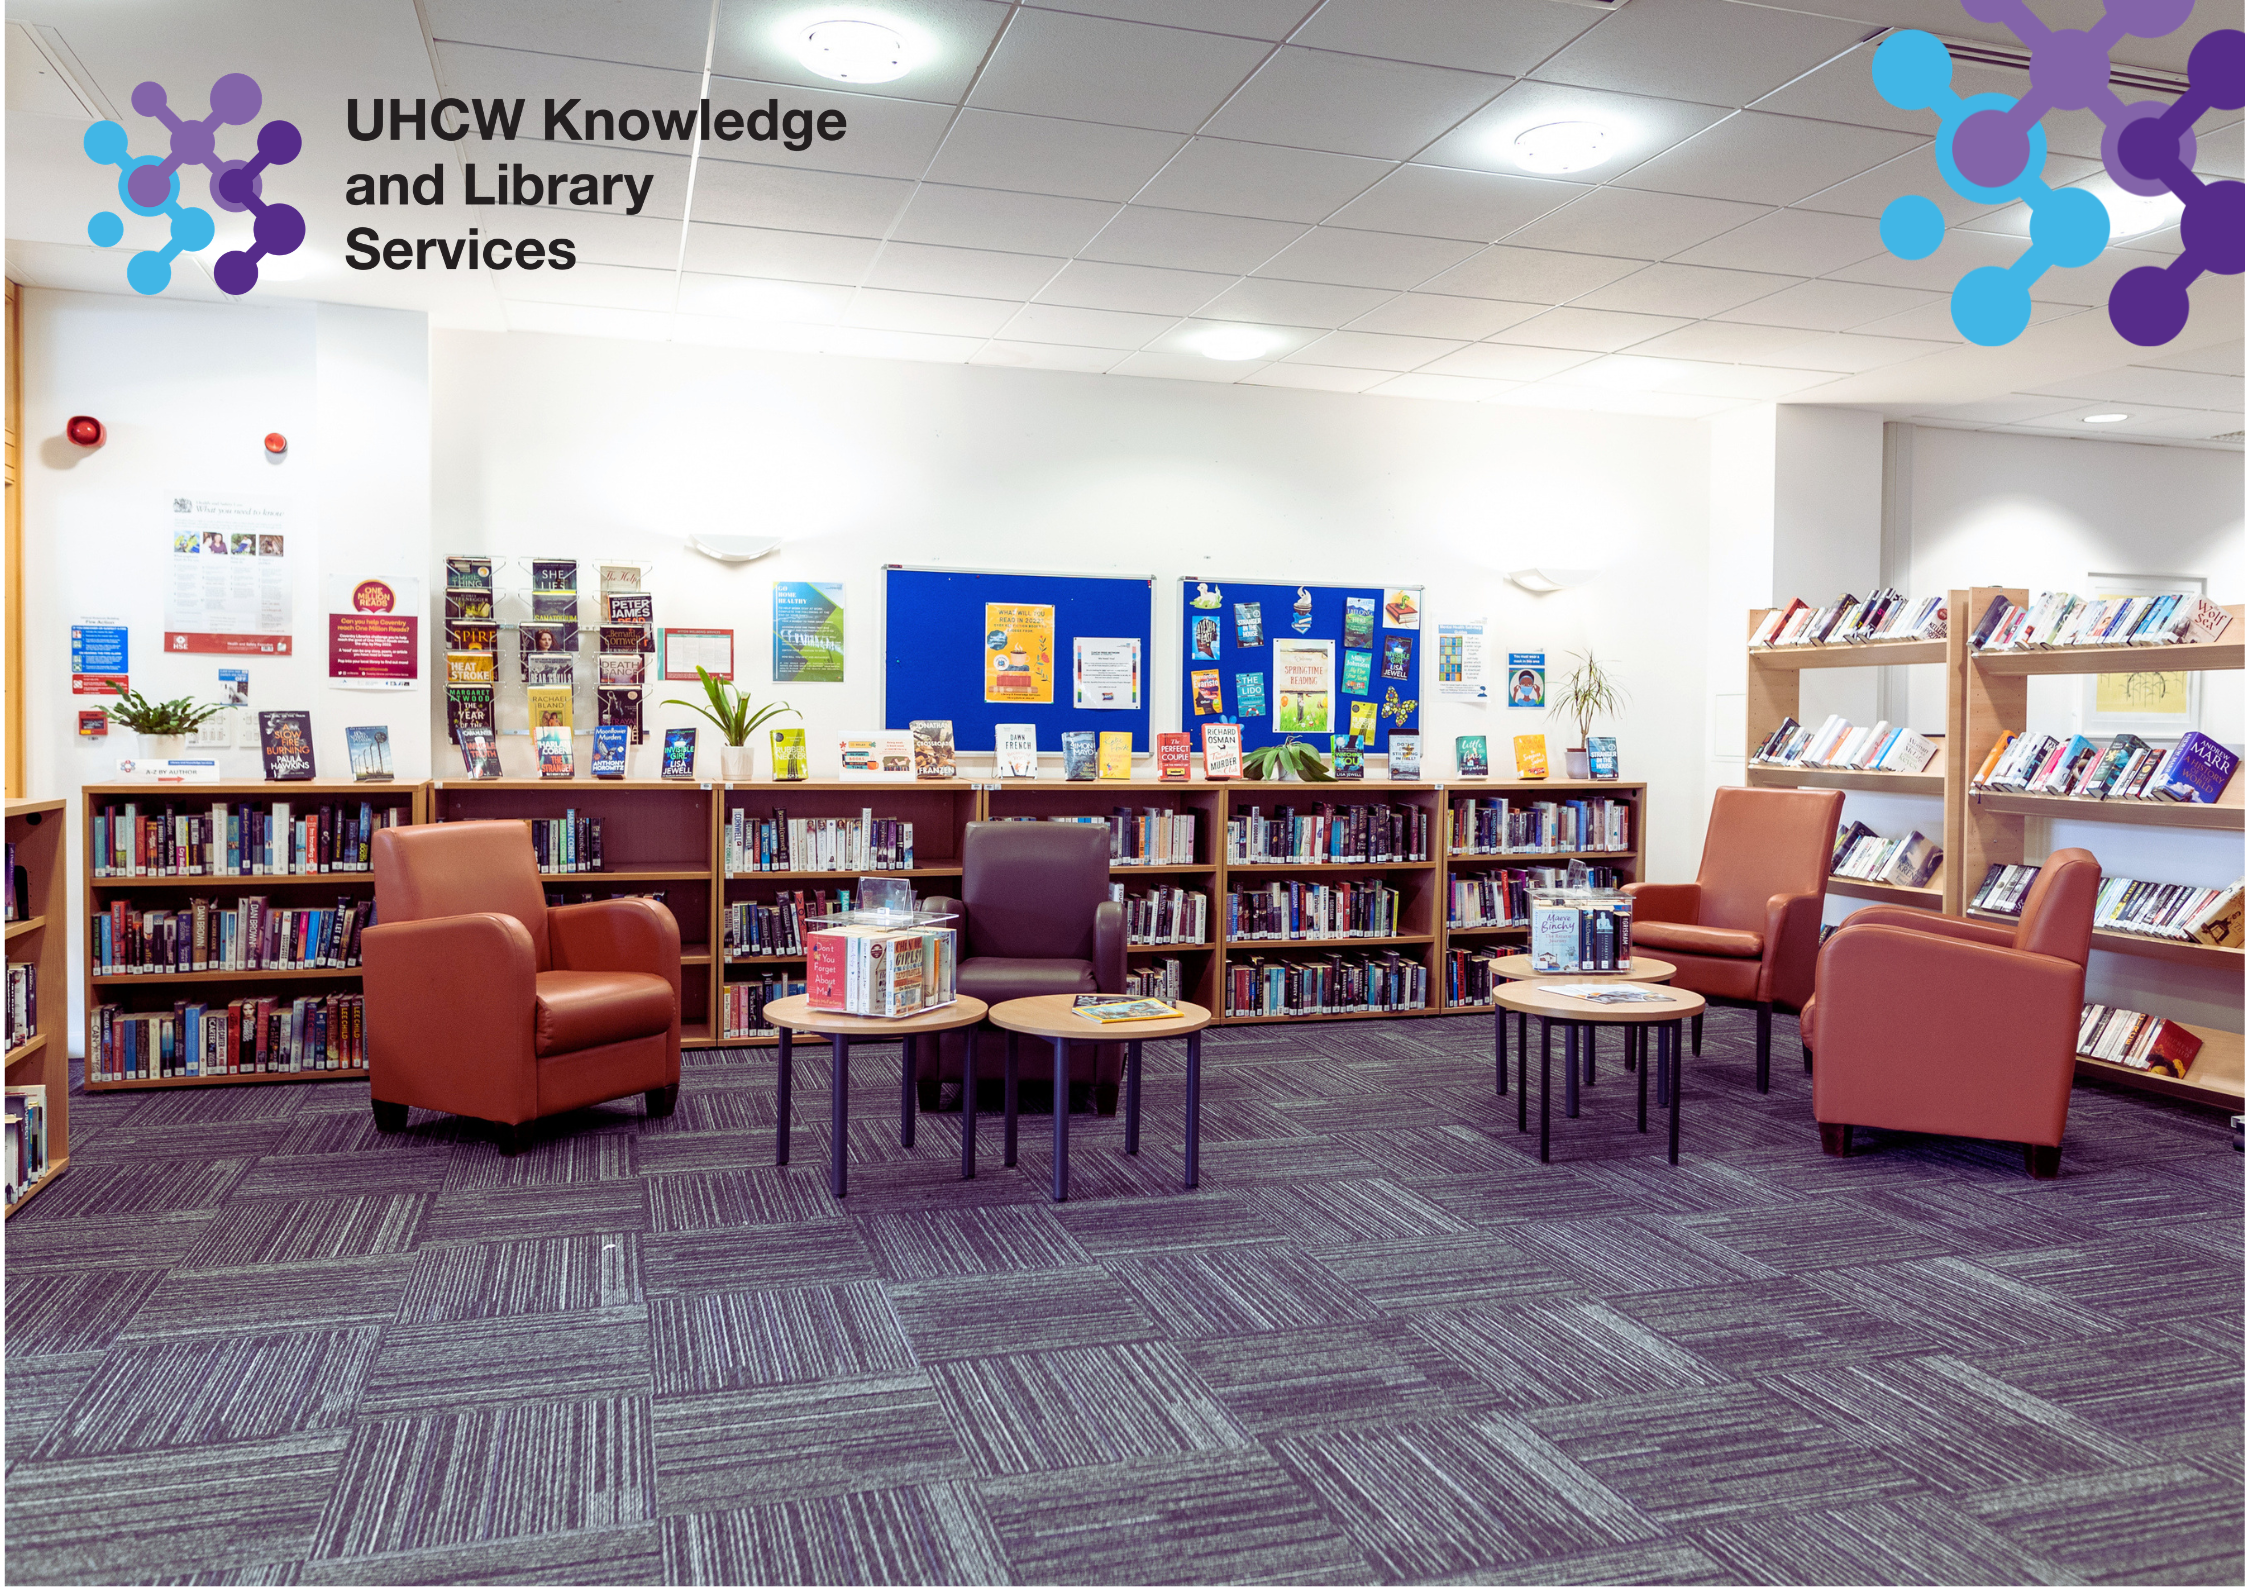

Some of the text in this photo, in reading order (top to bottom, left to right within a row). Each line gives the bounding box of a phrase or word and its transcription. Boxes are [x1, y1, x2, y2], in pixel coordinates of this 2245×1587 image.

[263, 508, 284, 517] know
[542, 570, 564, 579] SHE
[358, 592, 390, 600] MILLION
[612, 600, 650, 609] PETER
[612, 608, 650, 618] JAMES
[2198, 598, 2227, 627] Wolf
[2194, 612, 2214, 630] Sea
[454, 630, 497, 642] SPIRE
[451, 662, 476, 671] HEAT
[1284, 666, 1323, 674] SPRINGTIME
[452, 671, 490, 680] STROKE
[1290, 676, 1317, 685] READING
[458, 712, 484, 720] YEAR
[274, 730, 302, 739] SLOW
[282, 738, 300, 746] FIRE
[1006, 742, 1032, 750] FRENCH
[266, 746, 310, 755] BURNING
[2201, 740, 2230, 760] ANDREW
[2190, 742, 2230, 775] MARR
[270, 762, 310, 770] HAWKINS
[542, 763, 574, 772] STRANGER
[1210, 757, 1237, 770] MURDER
[2191, 759, 2225, 784] HISTORY
[2182, 768, 2214, 793] WORLD
[2201, 773, 2212, 783] THE
[337, 905, 345, 922] DON'T
[249, 904, 259, 945] DAN BROWN
[1541, 920, 1575, 934] Binchy
[817, 942, 834, 952] Don't
[822, 954, 835, 963] You
[896, 950, 922, 966] GIRLS!
[814, 962, 836, 974] Forget
[815, 974, 835, 984] About
[817, 987, 828, 996] Me
